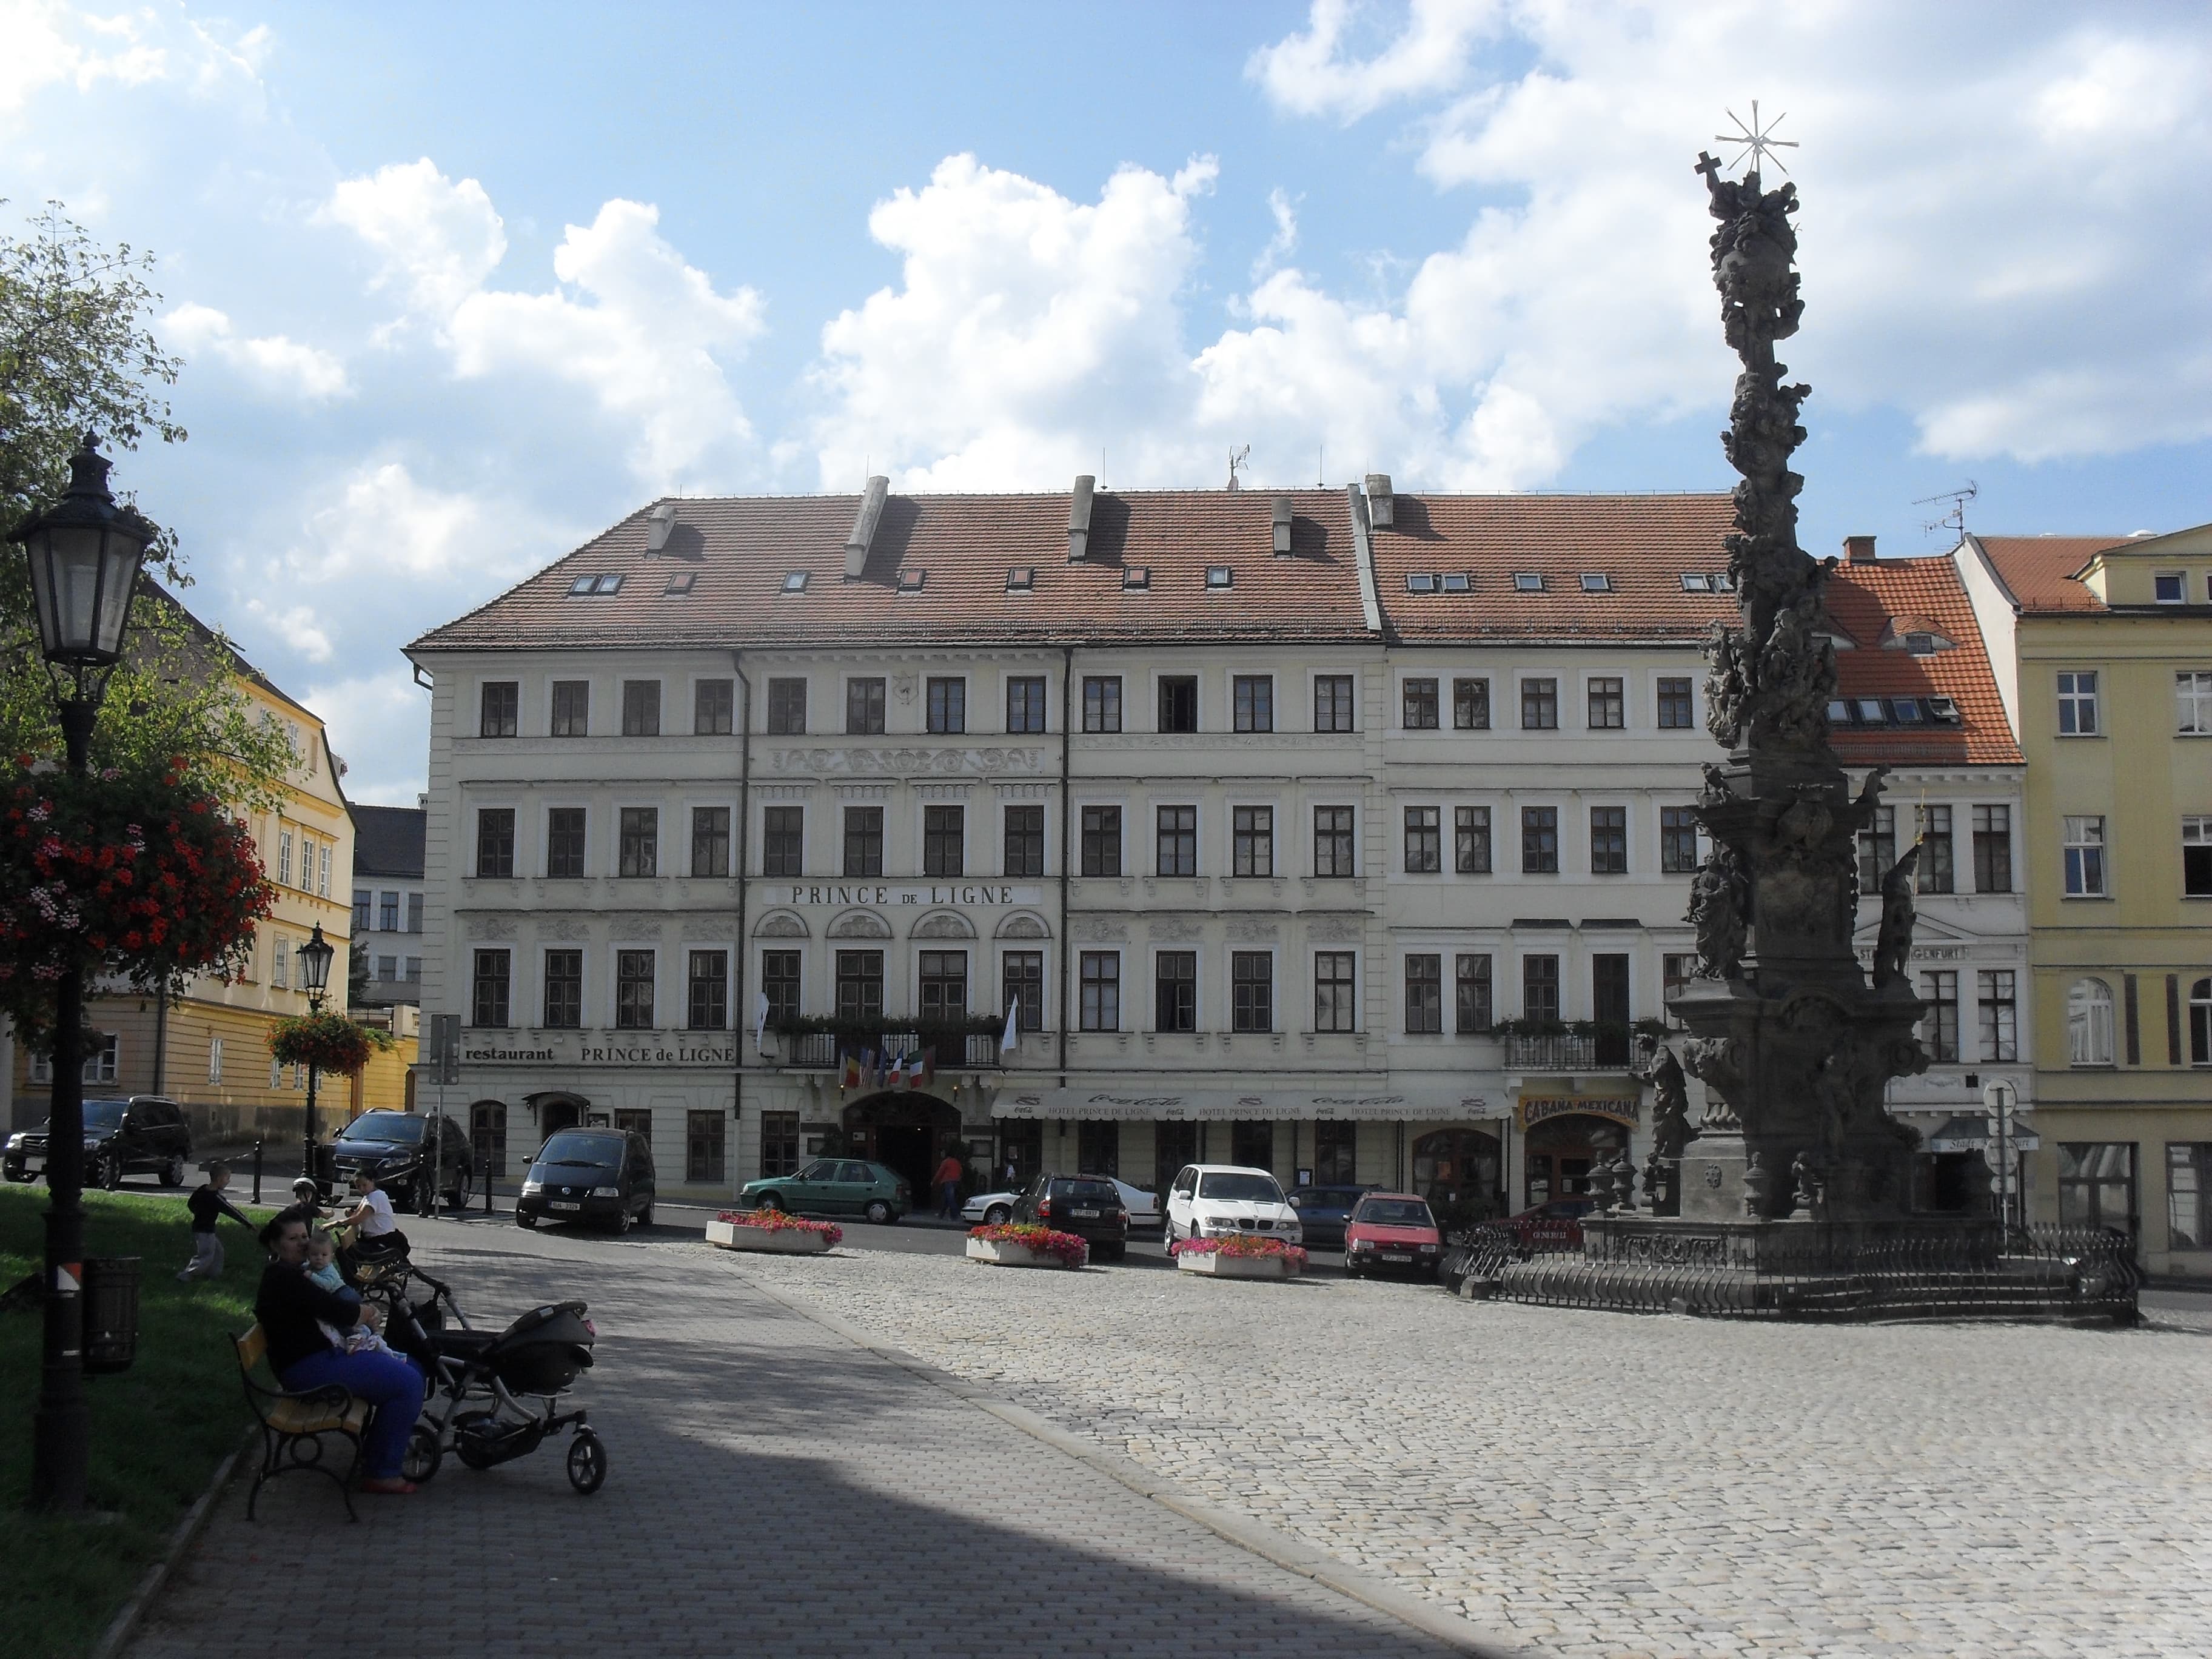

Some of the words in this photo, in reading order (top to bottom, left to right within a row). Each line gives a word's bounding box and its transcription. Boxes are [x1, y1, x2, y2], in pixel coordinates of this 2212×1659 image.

[791, 886, 887, 903] PRINCE
[902, 894, 917, 904] DE
[931, 886, 1013, 903] LIGNE
[465, 1048, 554, 1060] restaurant
[581, 1048, 651, 1061] PRINCE
[656, 1048, 672, 1061] de
[679, 1048, 734, 1061] LIGNE
[1048, 1107, 1075, 1116] HOTEL
[1079, 1107, 1109, 1116] PRINCE
[1199, 1107, 1225, 1116] HOTEL
[1230, 1107, 1260, 1116] PRINCE
[1262, 1107, 1272, 1116] DE
[1276, 1107, 1301, 1115] LIGNE
[1352, 1107, 1377, 1116] HOTEL
[1381, 1107, 1409, 1116] PRINCE
[1413, 1107, 1423, 1116] DE
[1426, 1107, 1451, 1116] LIGNE
[1578, 1100, 1640, 1122] MEXICANA
